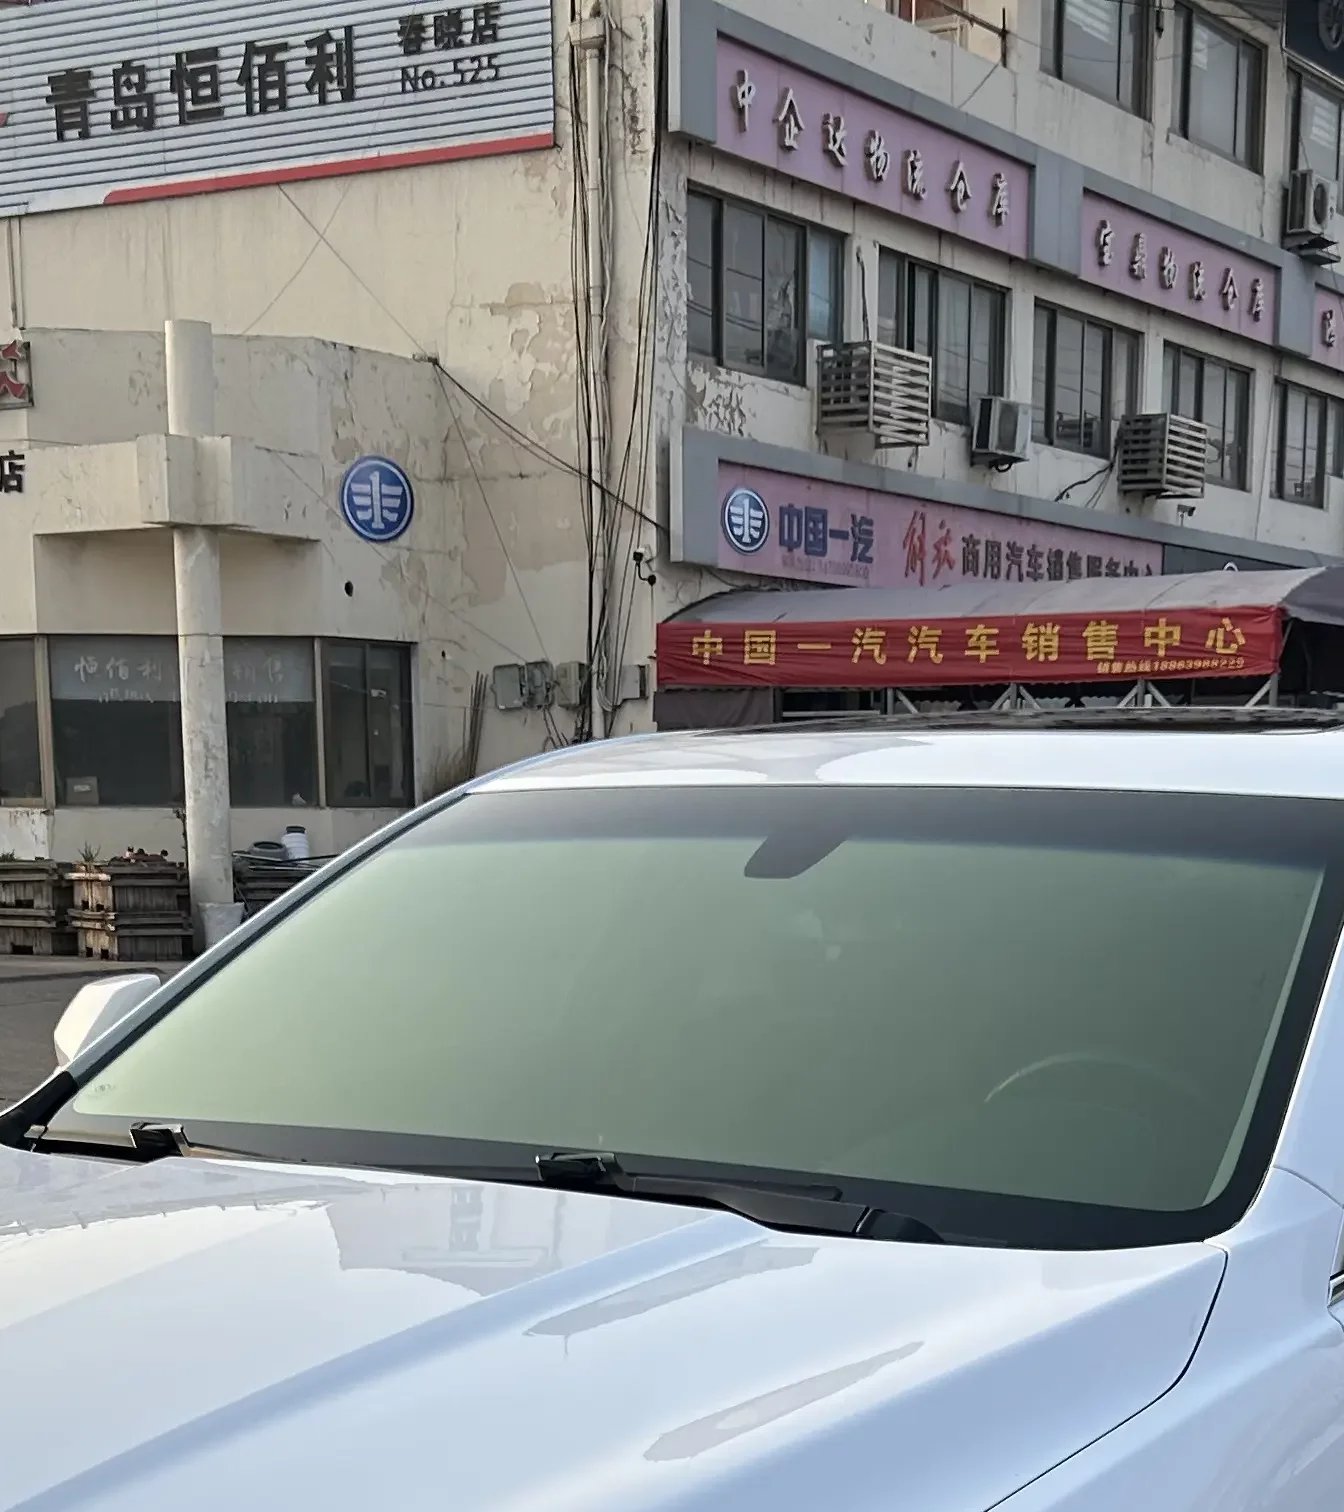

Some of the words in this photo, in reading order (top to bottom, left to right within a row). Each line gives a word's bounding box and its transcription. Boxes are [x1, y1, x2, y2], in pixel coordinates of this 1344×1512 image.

[45, 25, 356, 142] 青岛恒佰利
[778, 502, 875, 564] 中国一汽
[902, 510, 957, 588] 解放
[691, 617, 1246, 667] 中国一汽汽车销售中心
